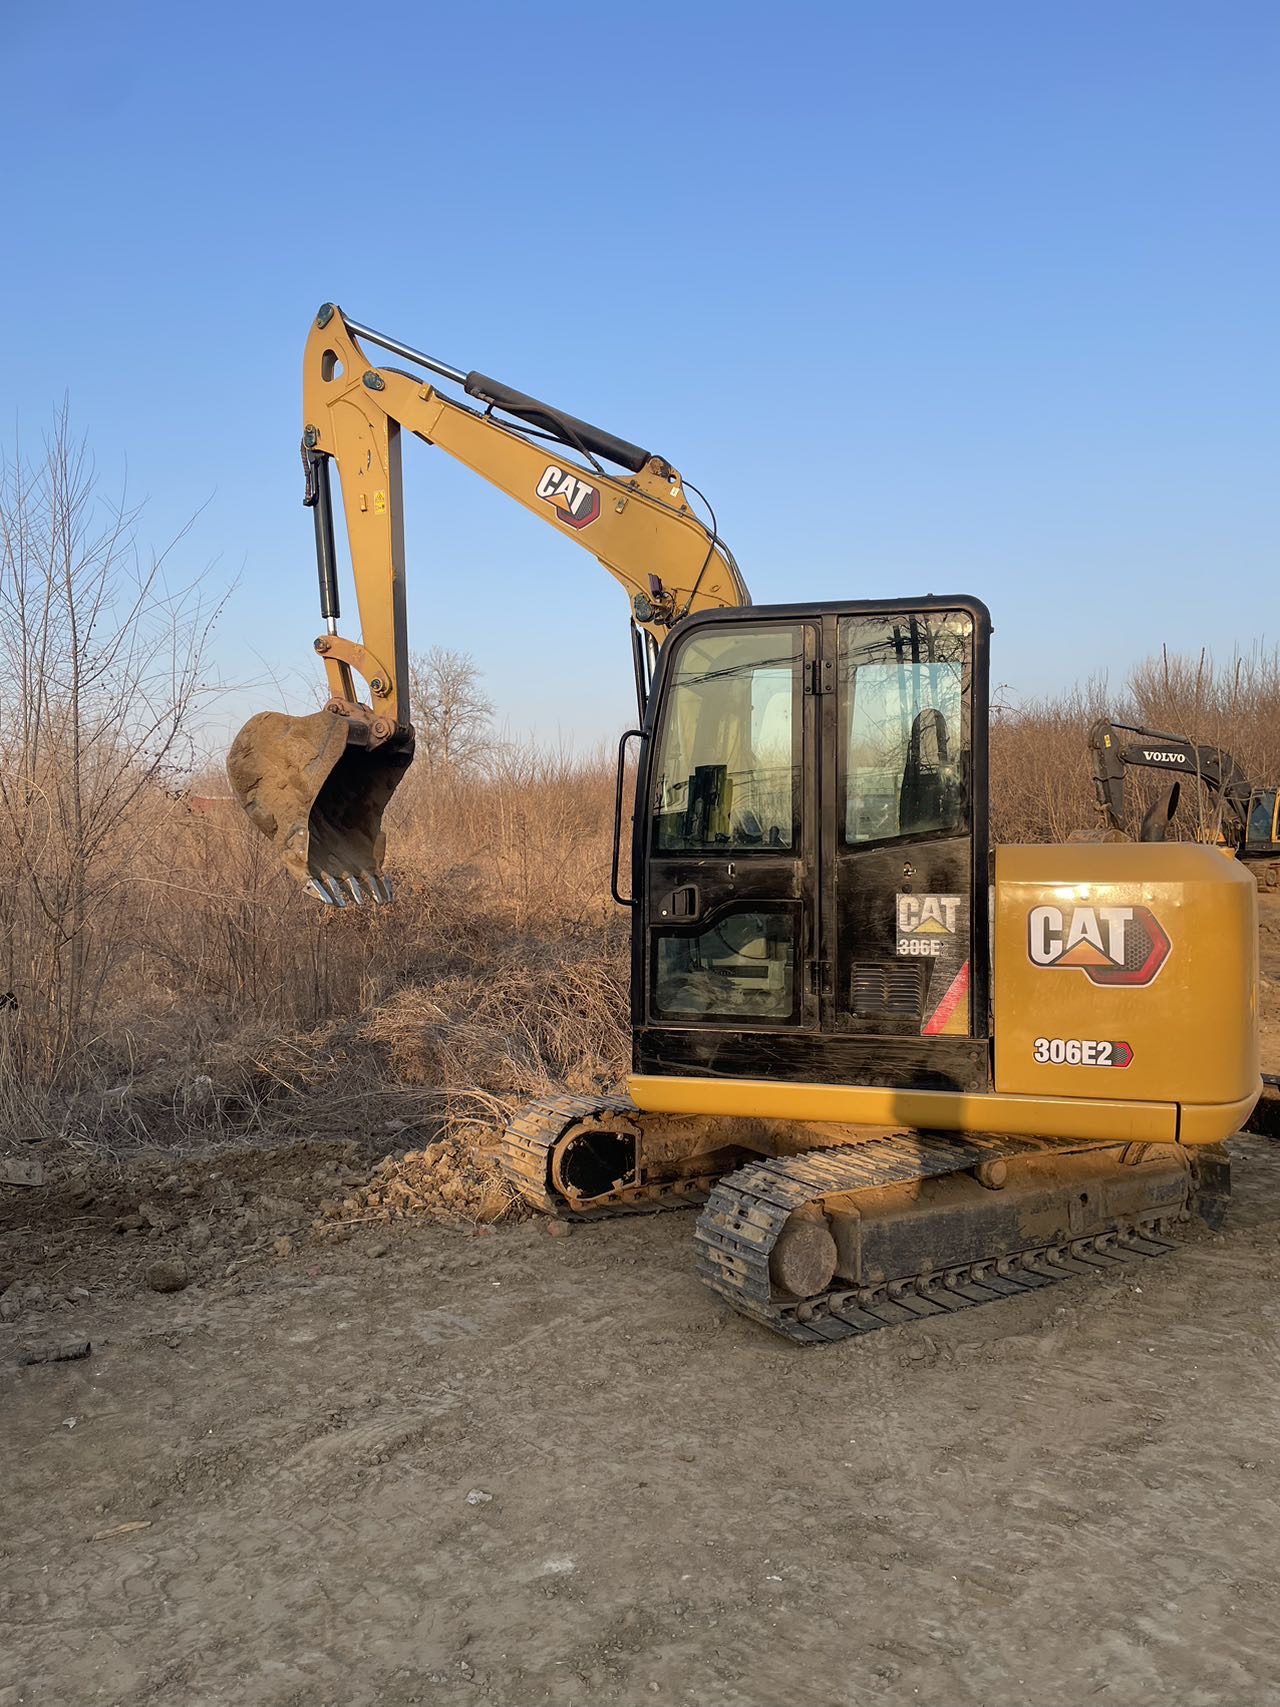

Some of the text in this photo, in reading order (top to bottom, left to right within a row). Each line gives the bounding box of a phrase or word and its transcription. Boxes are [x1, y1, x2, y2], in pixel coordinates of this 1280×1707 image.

[537, 465, 594, 515] CAT
[1142, 751, 1186, 763] VOLVO
[899, 896, 961, 933] CAT
[1030, 906, 1133, 966] CAT
[1034, 1038, 1112, 1066] 306E2
